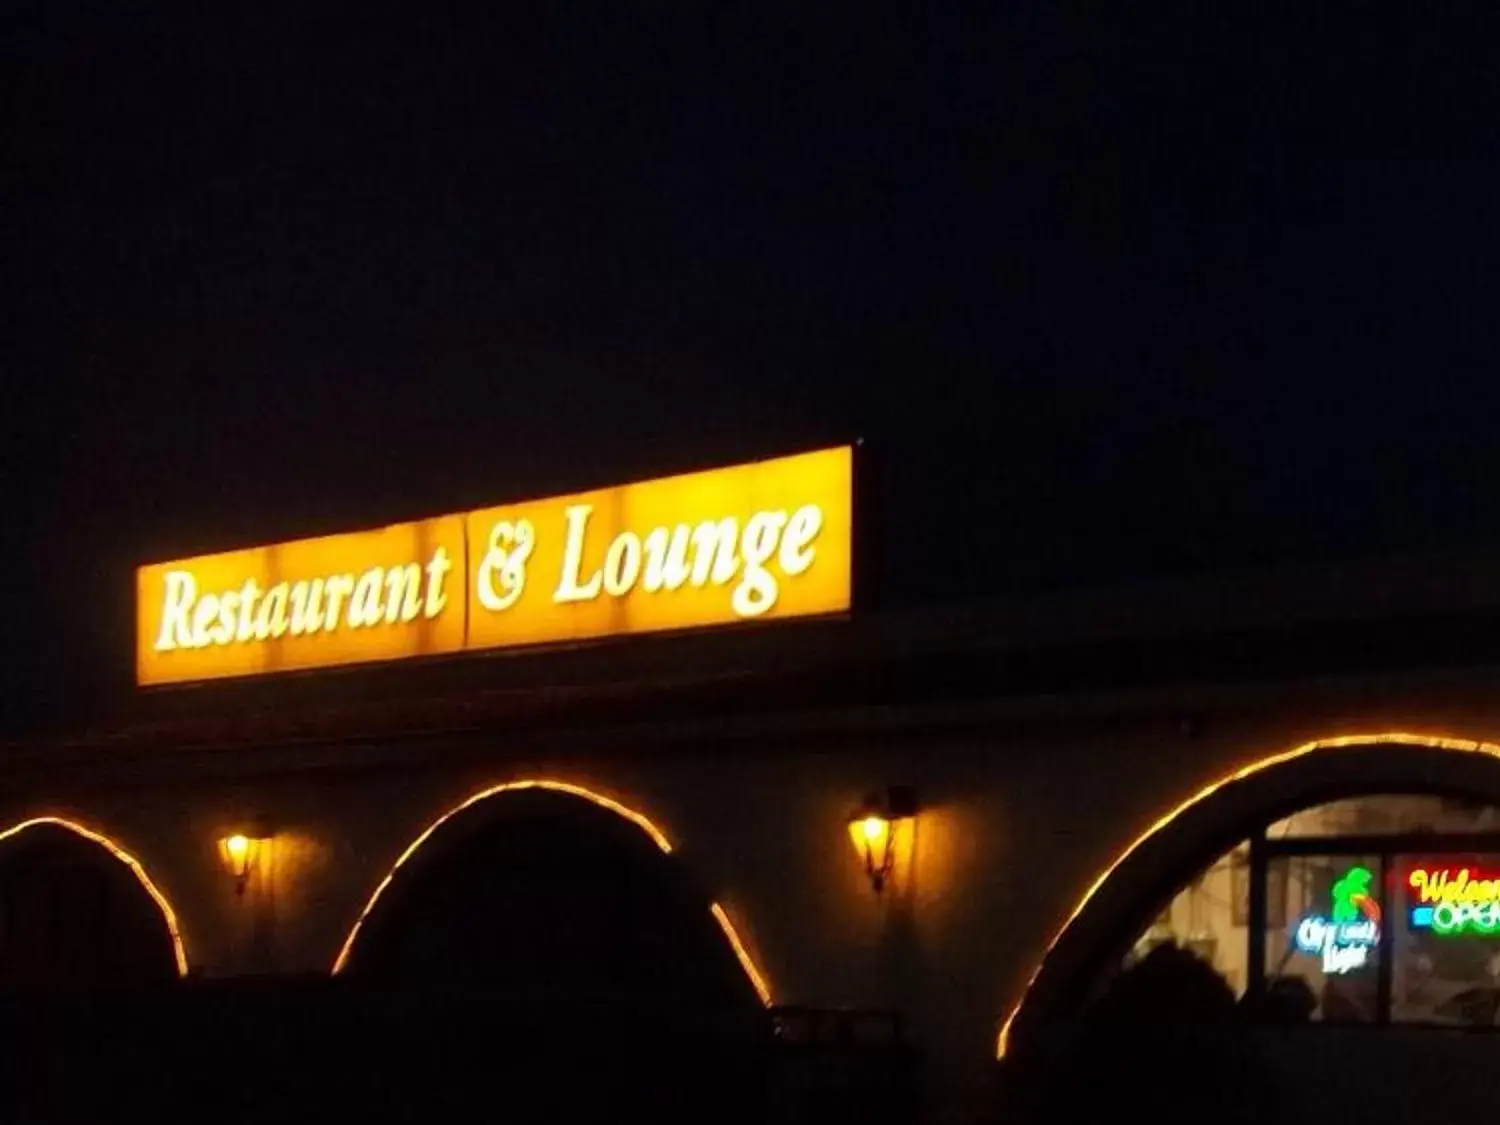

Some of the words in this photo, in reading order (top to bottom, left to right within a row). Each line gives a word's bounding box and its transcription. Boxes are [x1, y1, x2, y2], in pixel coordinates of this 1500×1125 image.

[154, 544, 450, 651] Restaurant
[476, 517, 534, 610] &
[552, 503, 822, 618] Lounge
